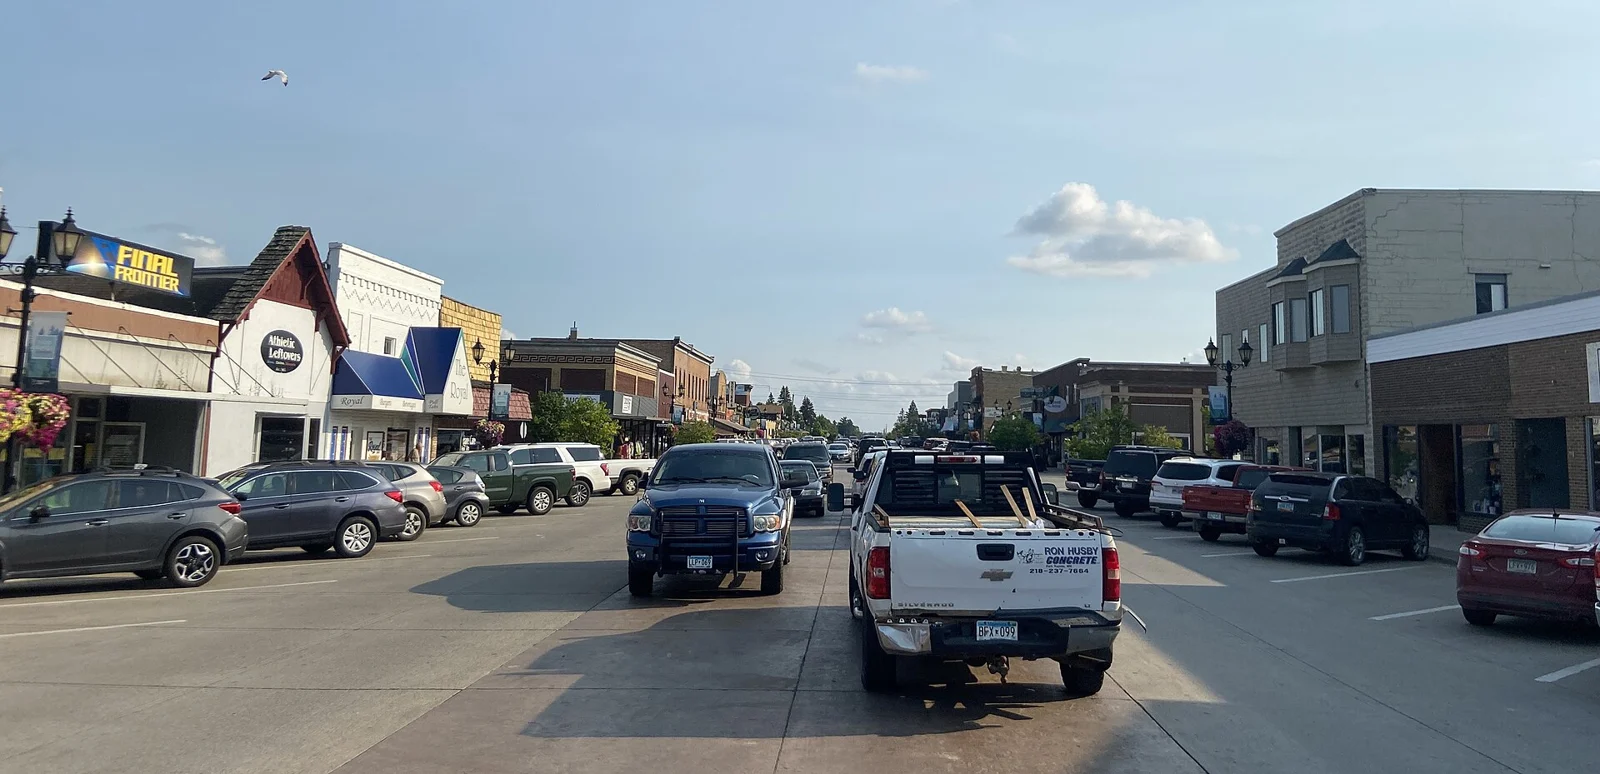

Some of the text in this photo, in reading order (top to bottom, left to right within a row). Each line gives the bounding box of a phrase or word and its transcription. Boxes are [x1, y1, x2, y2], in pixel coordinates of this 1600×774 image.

[117, 245, 178, 277] FINAL
[114, 265, 178, 292] FRONTIER
[268, 335, 296, 348] Athletic
[268, 347, 300, 361] Leftovers
[456, 359, 466, 376] The
[450, 382, 468, 405] Royal
[341, 396, 365, 406] Royal
[1044, 546, 1098, 555] RON HUSBY
[1046, 556, 1098, 564] CONCRETE
